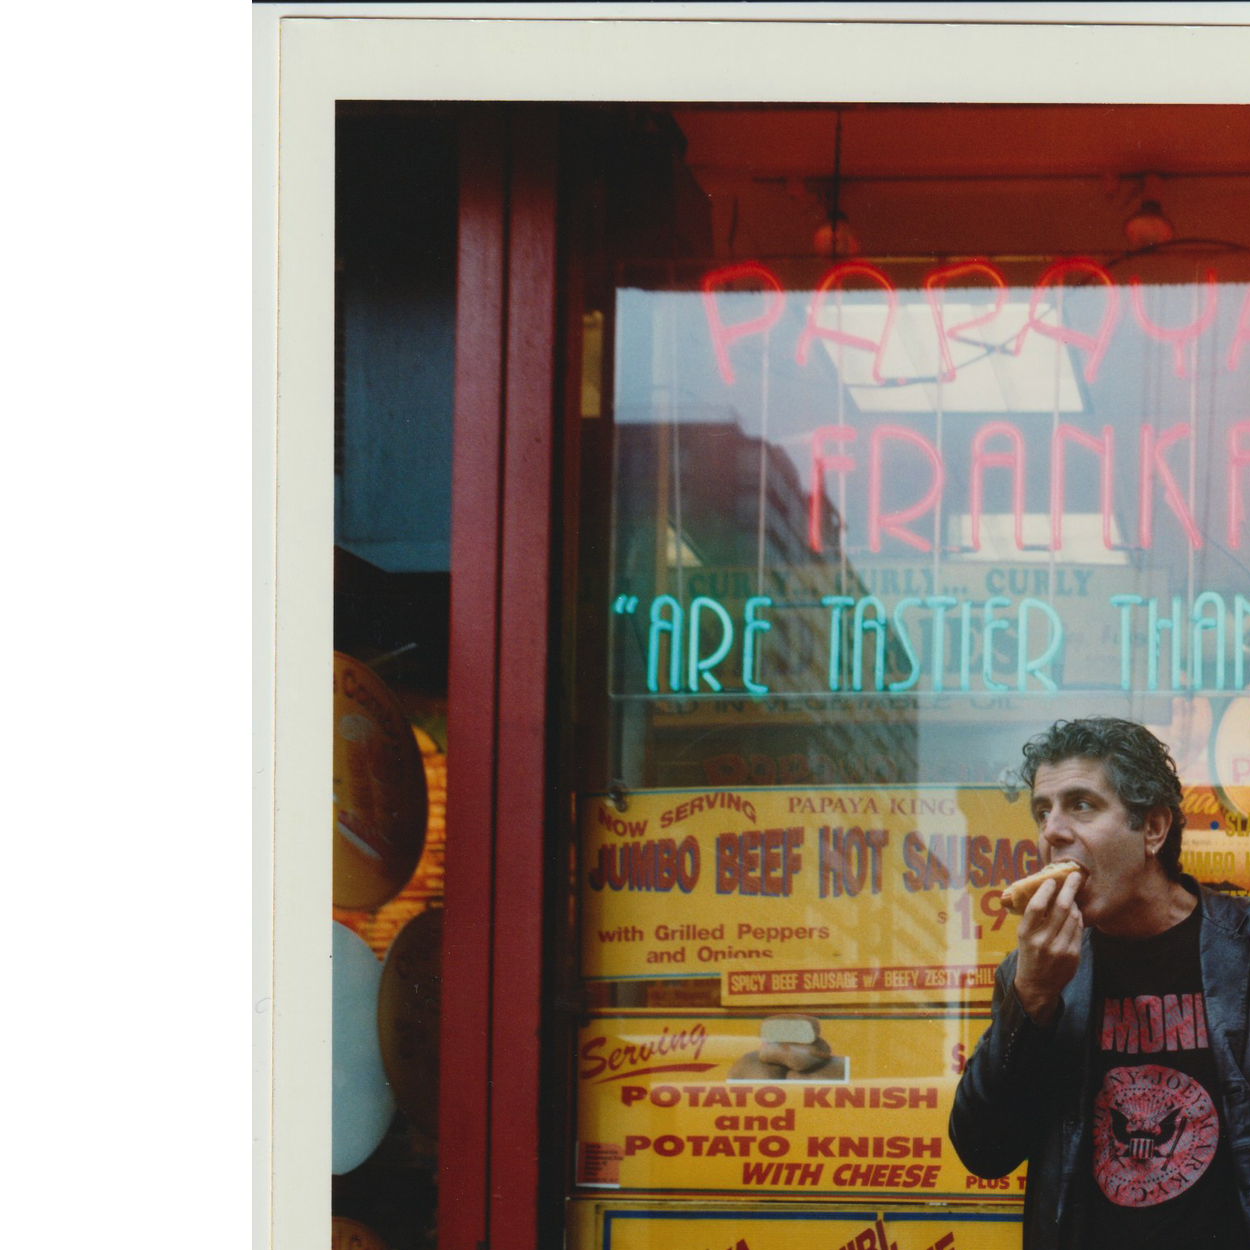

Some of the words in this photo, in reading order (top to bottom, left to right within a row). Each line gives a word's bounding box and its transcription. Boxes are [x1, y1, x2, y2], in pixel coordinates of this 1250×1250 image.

[822, 593, 1064, 694] TASTIER
[598, 807, 648, 838] NOW
[660, 792, 758, 829] SERVING
[787, 797, 880, 815] PAPAYA
[890, 797, 958, 816] KING
[589, 835, 702, 894] JUMBO
[715, 826, 806, 898] BEEF
[819, 826, 890, 899] HOT
[902, 831, 1044, 893] SAUSAG
[1180, 851, 1235, 876] UMBO
[938, 889, 1008, 940] $1.9
[598, 926, 644, 943] with
[655, 924, 725, 941] Grilled
[738, 923, 830, 946] Peppers
[646, 946, 686, 963] and
[730, 974, 766, 992] SPICY
[771, 973, 798, 990] BEEF
[803, 972, 858, 989] SAUSAGE
[884, 970, 919, 987] BEEFY
[924, 969, 960, 986] ZESTY
[966, 967, 996, 985] CHIL
[580, 1023, 709, 1081] Serving
[620, 1086, 786, 1108] POTATO
[803, 1086, 938, 1109] KNISH
[714, 1108, 796, 1131] and
[624, 1135, 790, 1158] POTATO
[807, 1136, 942, 1159] KNISH
[742, 1163, 823, 1186] WITH
[832, 1164, 942, 1188] CHEESE
[965, 1176, 1010, 1190] PLUS
